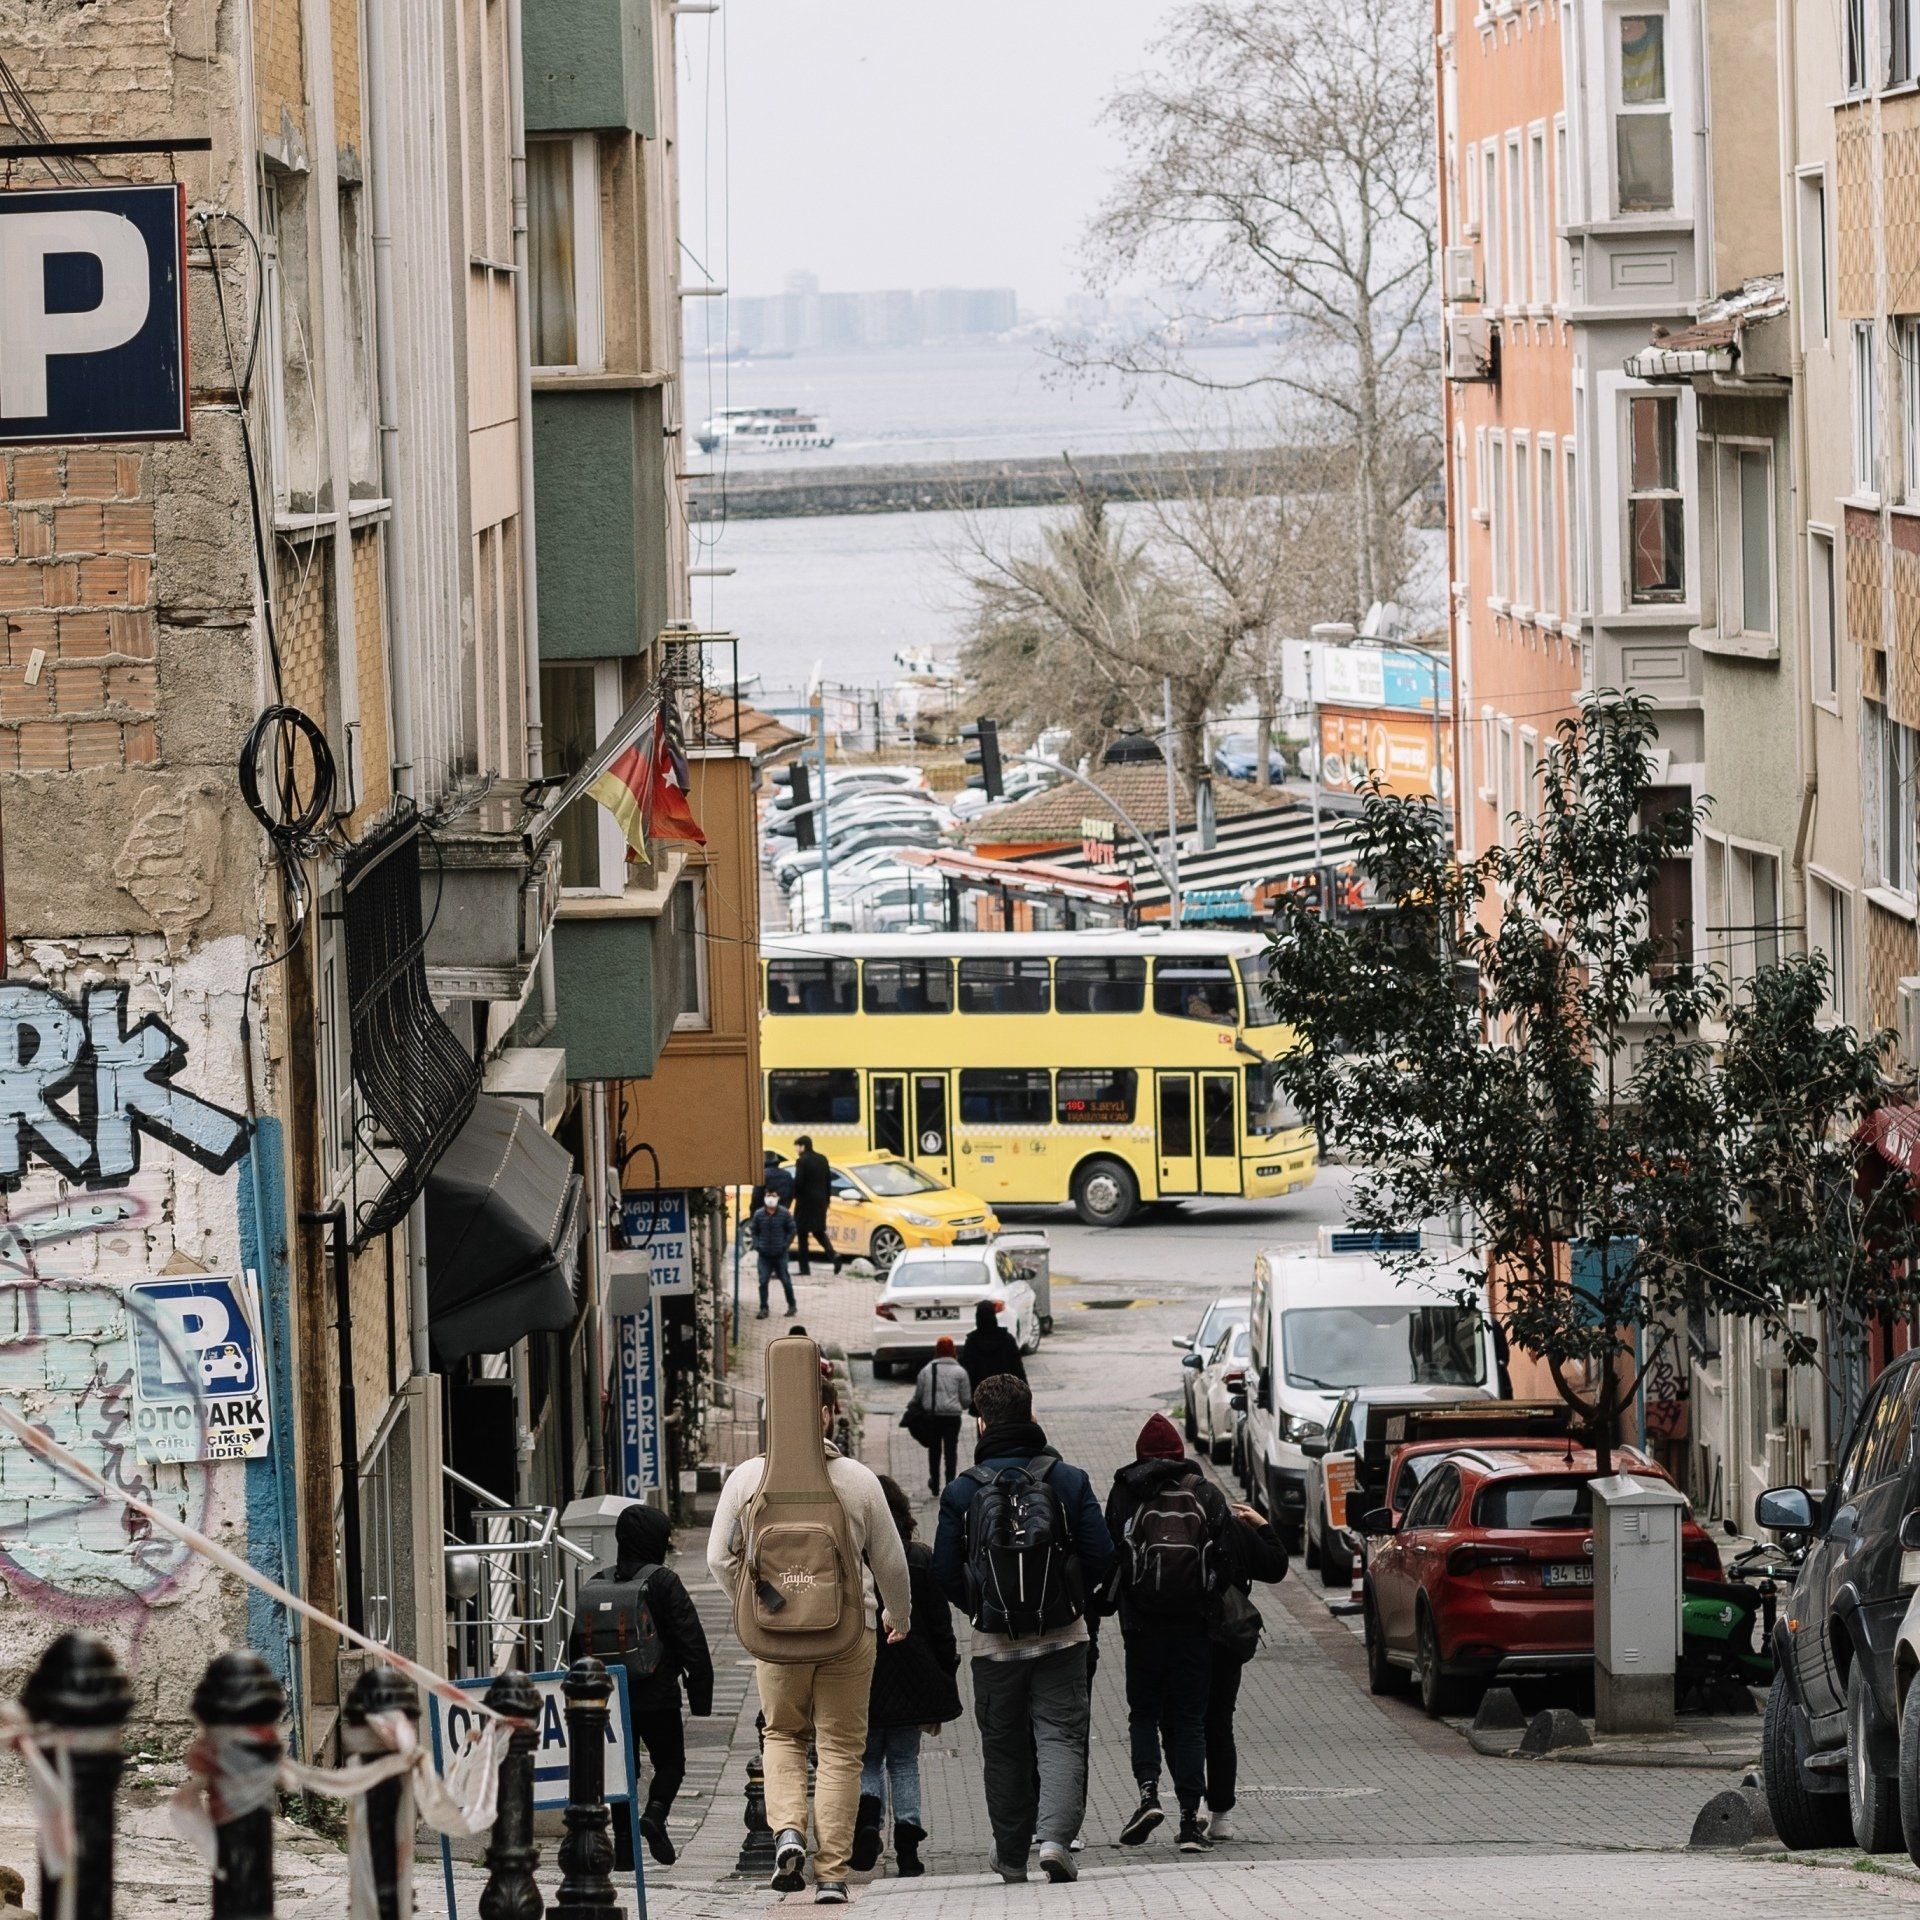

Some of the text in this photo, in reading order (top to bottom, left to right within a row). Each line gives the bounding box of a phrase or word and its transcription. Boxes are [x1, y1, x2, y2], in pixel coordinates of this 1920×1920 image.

[0, 210, 150, 418] P
[155, 1296, 230, 1385] P
[779, 1571, 816, 1587] Taylor
[1551, 1566, 1568, 1581] 34
